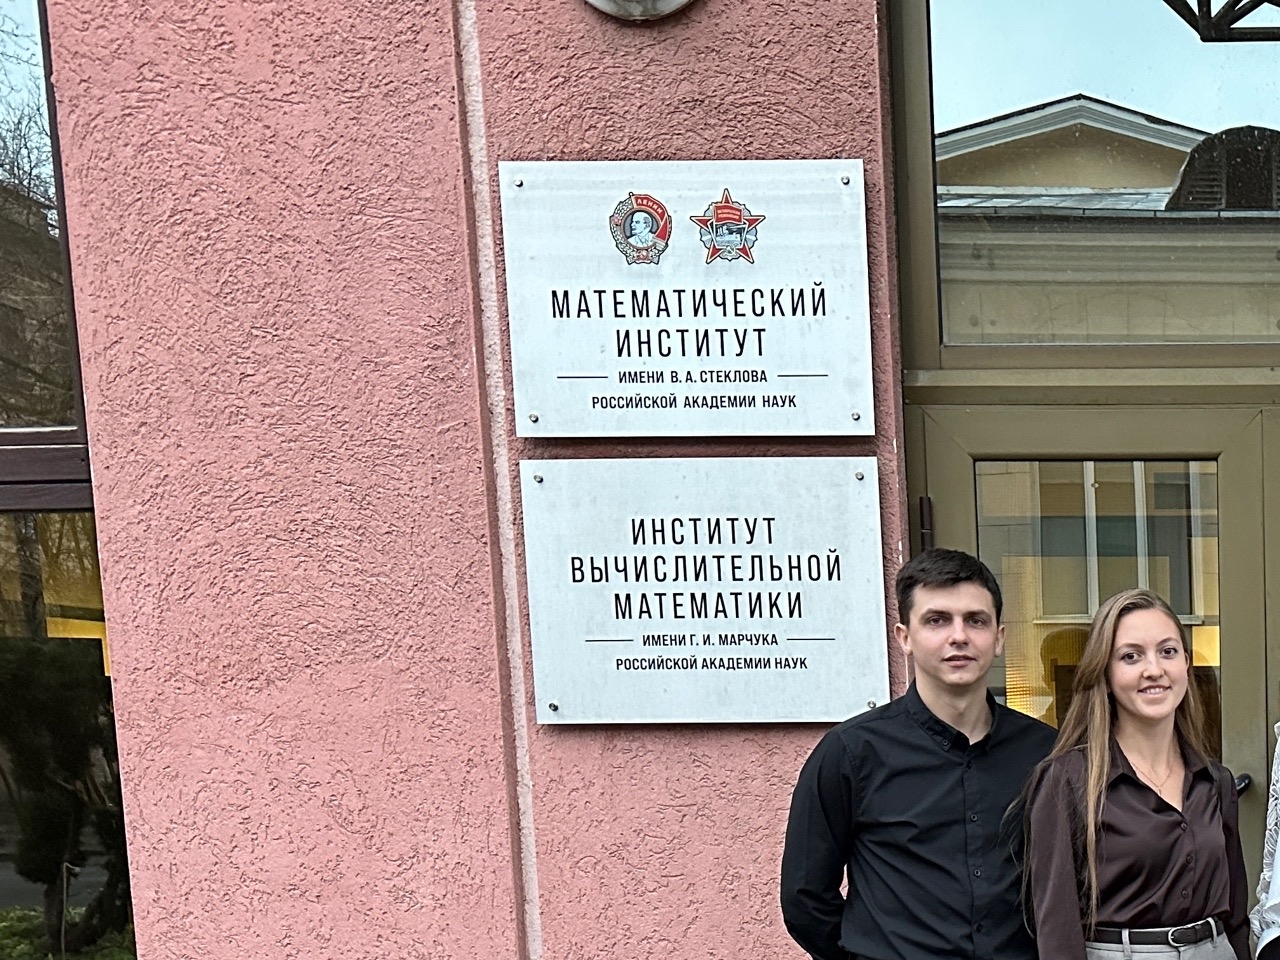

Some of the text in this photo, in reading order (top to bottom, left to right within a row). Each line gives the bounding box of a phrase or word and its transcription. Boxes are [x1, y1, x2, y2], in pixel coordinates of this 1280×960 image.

[551, 281, 826, 319] МАТЕМАТИЧЕСКИЙ
[616, 328, 767, 358] ИНСТИТУТ
[618, 369, 768, 384] ИМЕНИ В. А. СТЕКЛОВА
[591, 393, 797, 410] РОССИЙСКОЙ АКАДЕМИИ НАУК
[631, 517, 776, 546] ИНСТИТУТ
[570, 548, 841, 583] ВЫЧИСЛИТЕЛЬНОЙ
[614, 591, 802, 620] МАТЕМАТИКИ
[642, 633, 779, 647] ИМЕНИ Г. И. МАРЧУКА
[615, 654, 808, 671] РОССИЙСКОЙ АКАДЕМИИ НАУК
